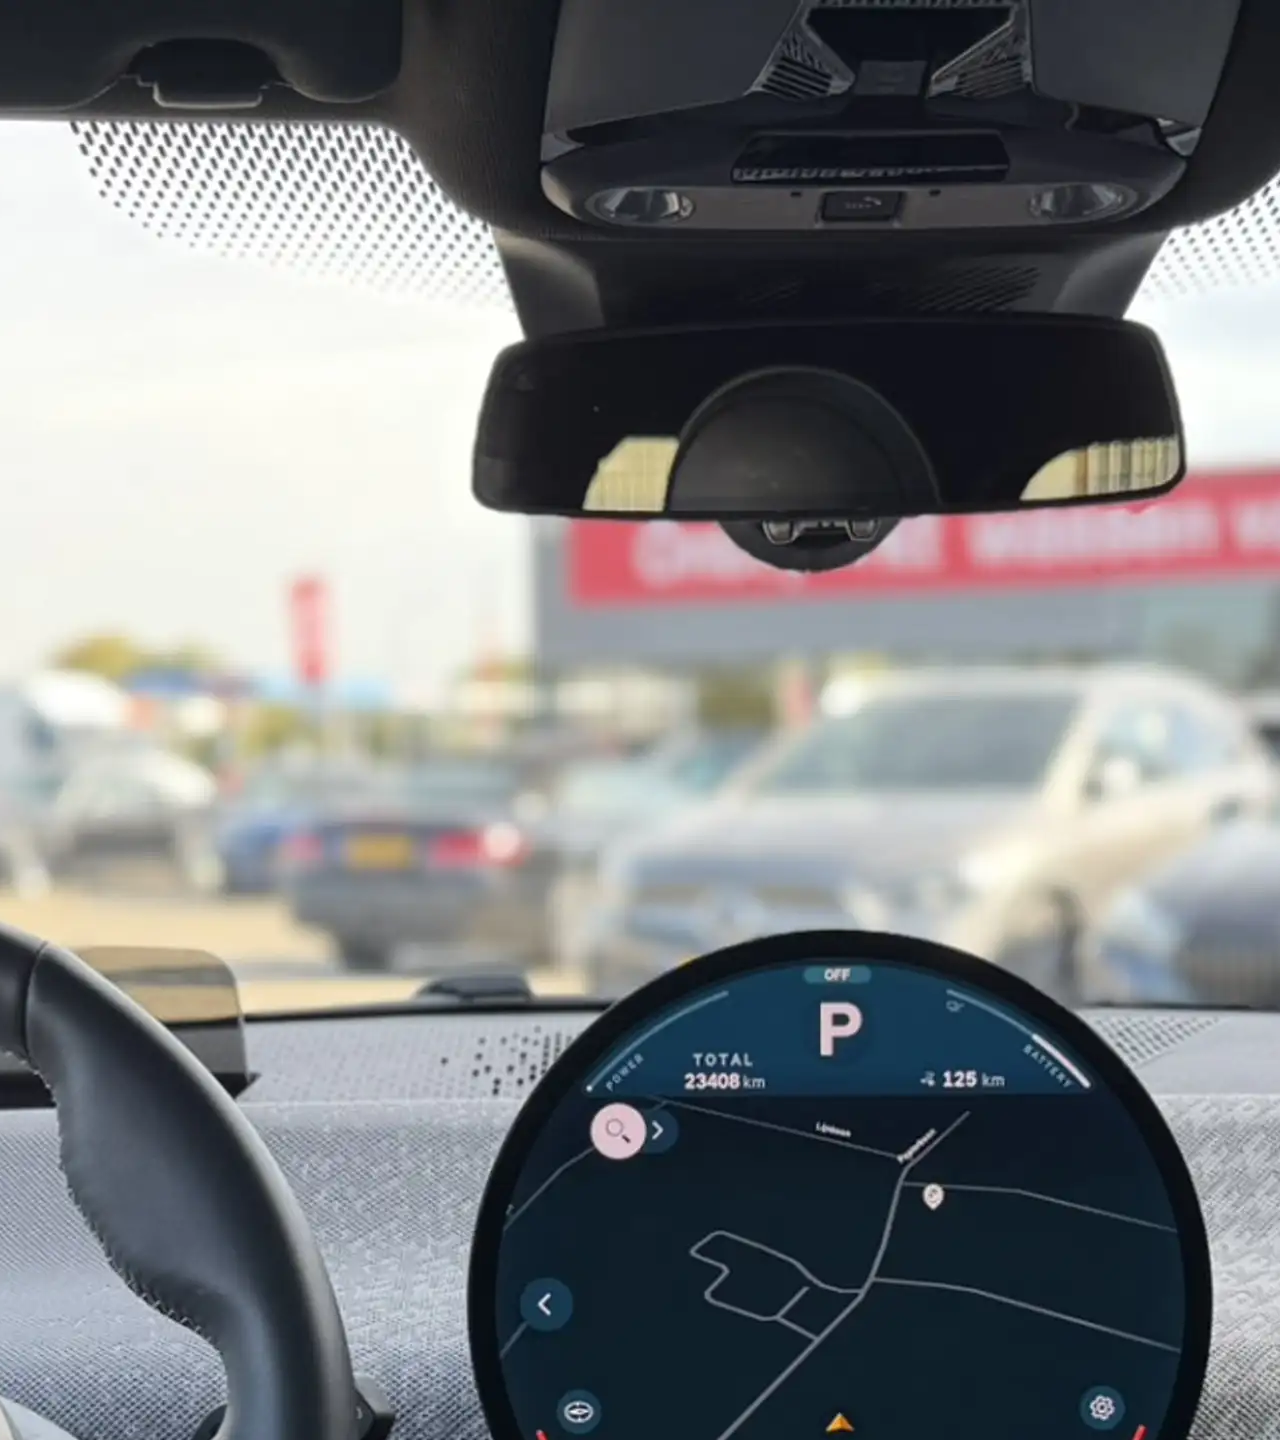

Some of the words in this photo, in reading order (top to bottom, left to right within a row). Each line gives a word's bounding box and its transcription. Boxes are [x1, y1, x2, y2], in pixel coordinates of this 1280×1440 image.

[823, 967, 852, 982] OFF
[819, 1001, 863, 1057] P
[692, 1053, 754, 1067] TOTAL
[1022, 1043, 1074, 1089] BATTERY
[605, 1053, 645, 1092] POWER
[683, 1072, 741, 1090] 23408
[742, 1074, 766, 1090] km
[942, 1070, 978, 1089] 125
[982, 1072, 1006, 1088] km
